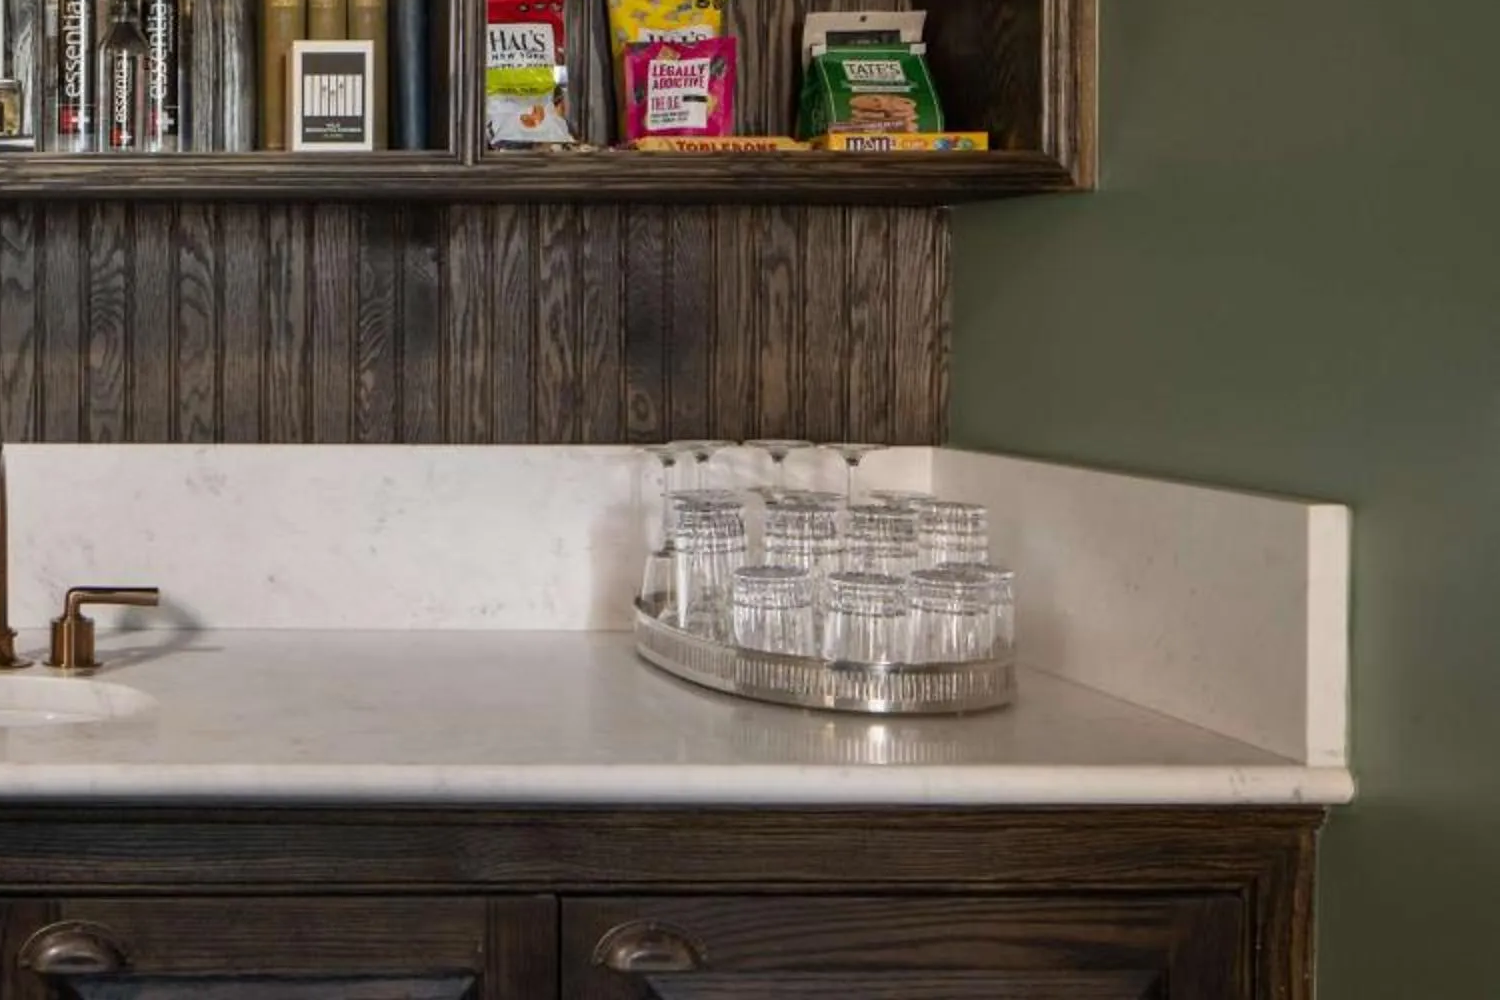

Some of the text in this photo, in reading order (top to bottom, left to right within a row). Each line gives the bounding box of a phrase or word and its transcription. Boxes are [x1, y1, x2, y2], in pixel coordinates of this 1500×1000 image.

[490, 30, 545, 52] HAL'S
[62, 1, 83, 98] essentia
[652, 64, 708, 77] LEGALLY
[846, 63, 901, 75] TATE'S
[652, 76, 706, 90] ADDICTIVE
